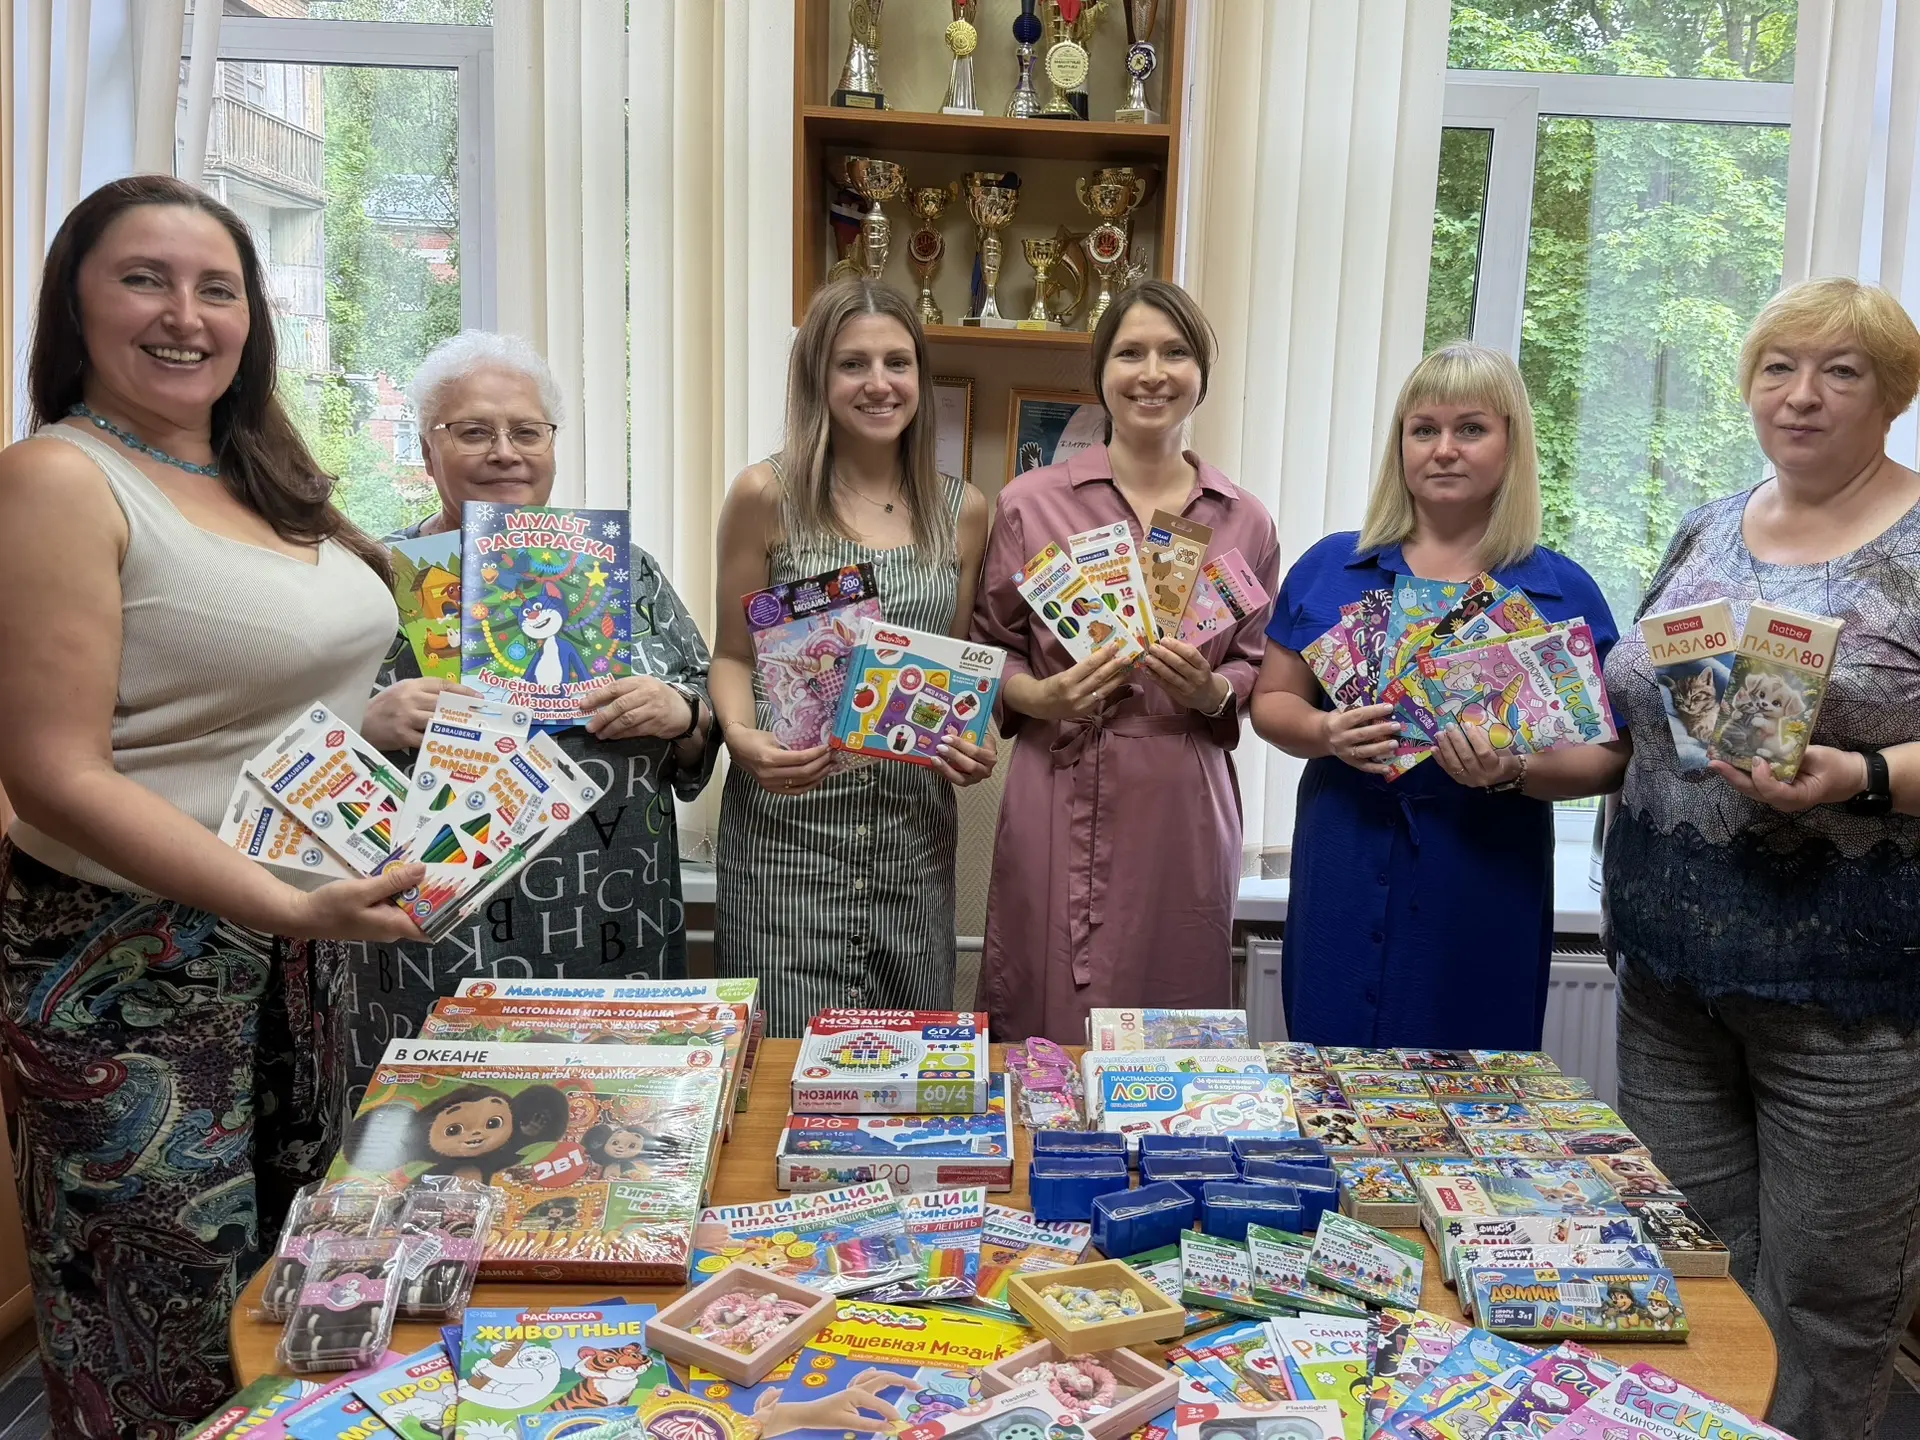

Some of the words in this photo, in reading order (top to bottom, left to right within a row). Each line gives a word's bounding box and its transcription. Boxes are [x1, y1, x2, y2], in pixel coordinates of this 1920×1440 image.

[505, 514, 590, 535] МУЛЬТ
[477, 531, 616, 563] РАСКРАСКА
[841, 578, 860, 591] 200
[1120, 586, 1133, 598] 12
[1665, 618, 1700, 634] hatber
[1770, 622, 1809, 642] hatber
[961, 646, 994, 666] Loto
[1518, 650, 1553, 698] ЕДИНОРОЖКИ
[507, 691, 582, 710] Лизюков
[441, 727, 476, 739] BRAUBERG
[426, 740, 500, 764] COLOURED
[279, 757, 311, 785] BRAUBERG
[430, 755, 488, 777] PENCILS
[286, 750, 348, 805] COLOURED
[519, 762, 544, 789] BRAUBERG
[302, 762, 354, 810] PENCILS
[355, 779, 377, 796] 12
[253, 812, 271, 847] BRAUBERG
[495, 830, 513, 849] 12
[501, 1005, 580, 1016] НАСТОЛЬНАЯ
[829, 1008, 916, 1018] МОЗАИКА
[511, 1020, 578, 1029] НАСТОЛЬНАЯ
[819, 1017, 912, 1026] МОЗАИКА
[927, 1026, 971, 1037] 60/4
[394, 1048, 408, 1061] В
[413, 1049, 489, 1063] ОКЕАНЕ
[461, 1071, 540, 1080] НАСТОЛЬНАЯ
[541, 1072, 571, 1080] ИГРА
[1110, 1075, 1175, 1083] ПЛАСТМАССОВОЕ
[799, 1089, 859, 1101] МОЗАИКА
[923, 1084, 968, 1102] 60/4
[1112, 1082, 1177, 1101] ЛОТО
[701, 1183, 885, 1223] АППЛИКАЦИИ
[731, 1194, 889, 1228] ПЛАСТИЛИНОМ
[872, 1204, 893, 1216] МИР
[934, 1219, 978, 1232] ЛЕПИТЬ
[1256, 1251, 1307, 1267] CRAYON
[522, 1312, 598, 1322] РАСКРАСКА
[475, 1320, 641, 1341] ЖИВОТНЫЕ
[1310, 1328, 1365, 1339] САМАЯ
[928, 1339, 1006, 1361] Мозаик
[1291, 1338, 1366, 1359] РАСК
[1000, 1388, 1038, 1406] Flashlight
[1187, 1407, 1205, 1415] 3+
[1285, 1404, 1328, 1412] Flashlight
